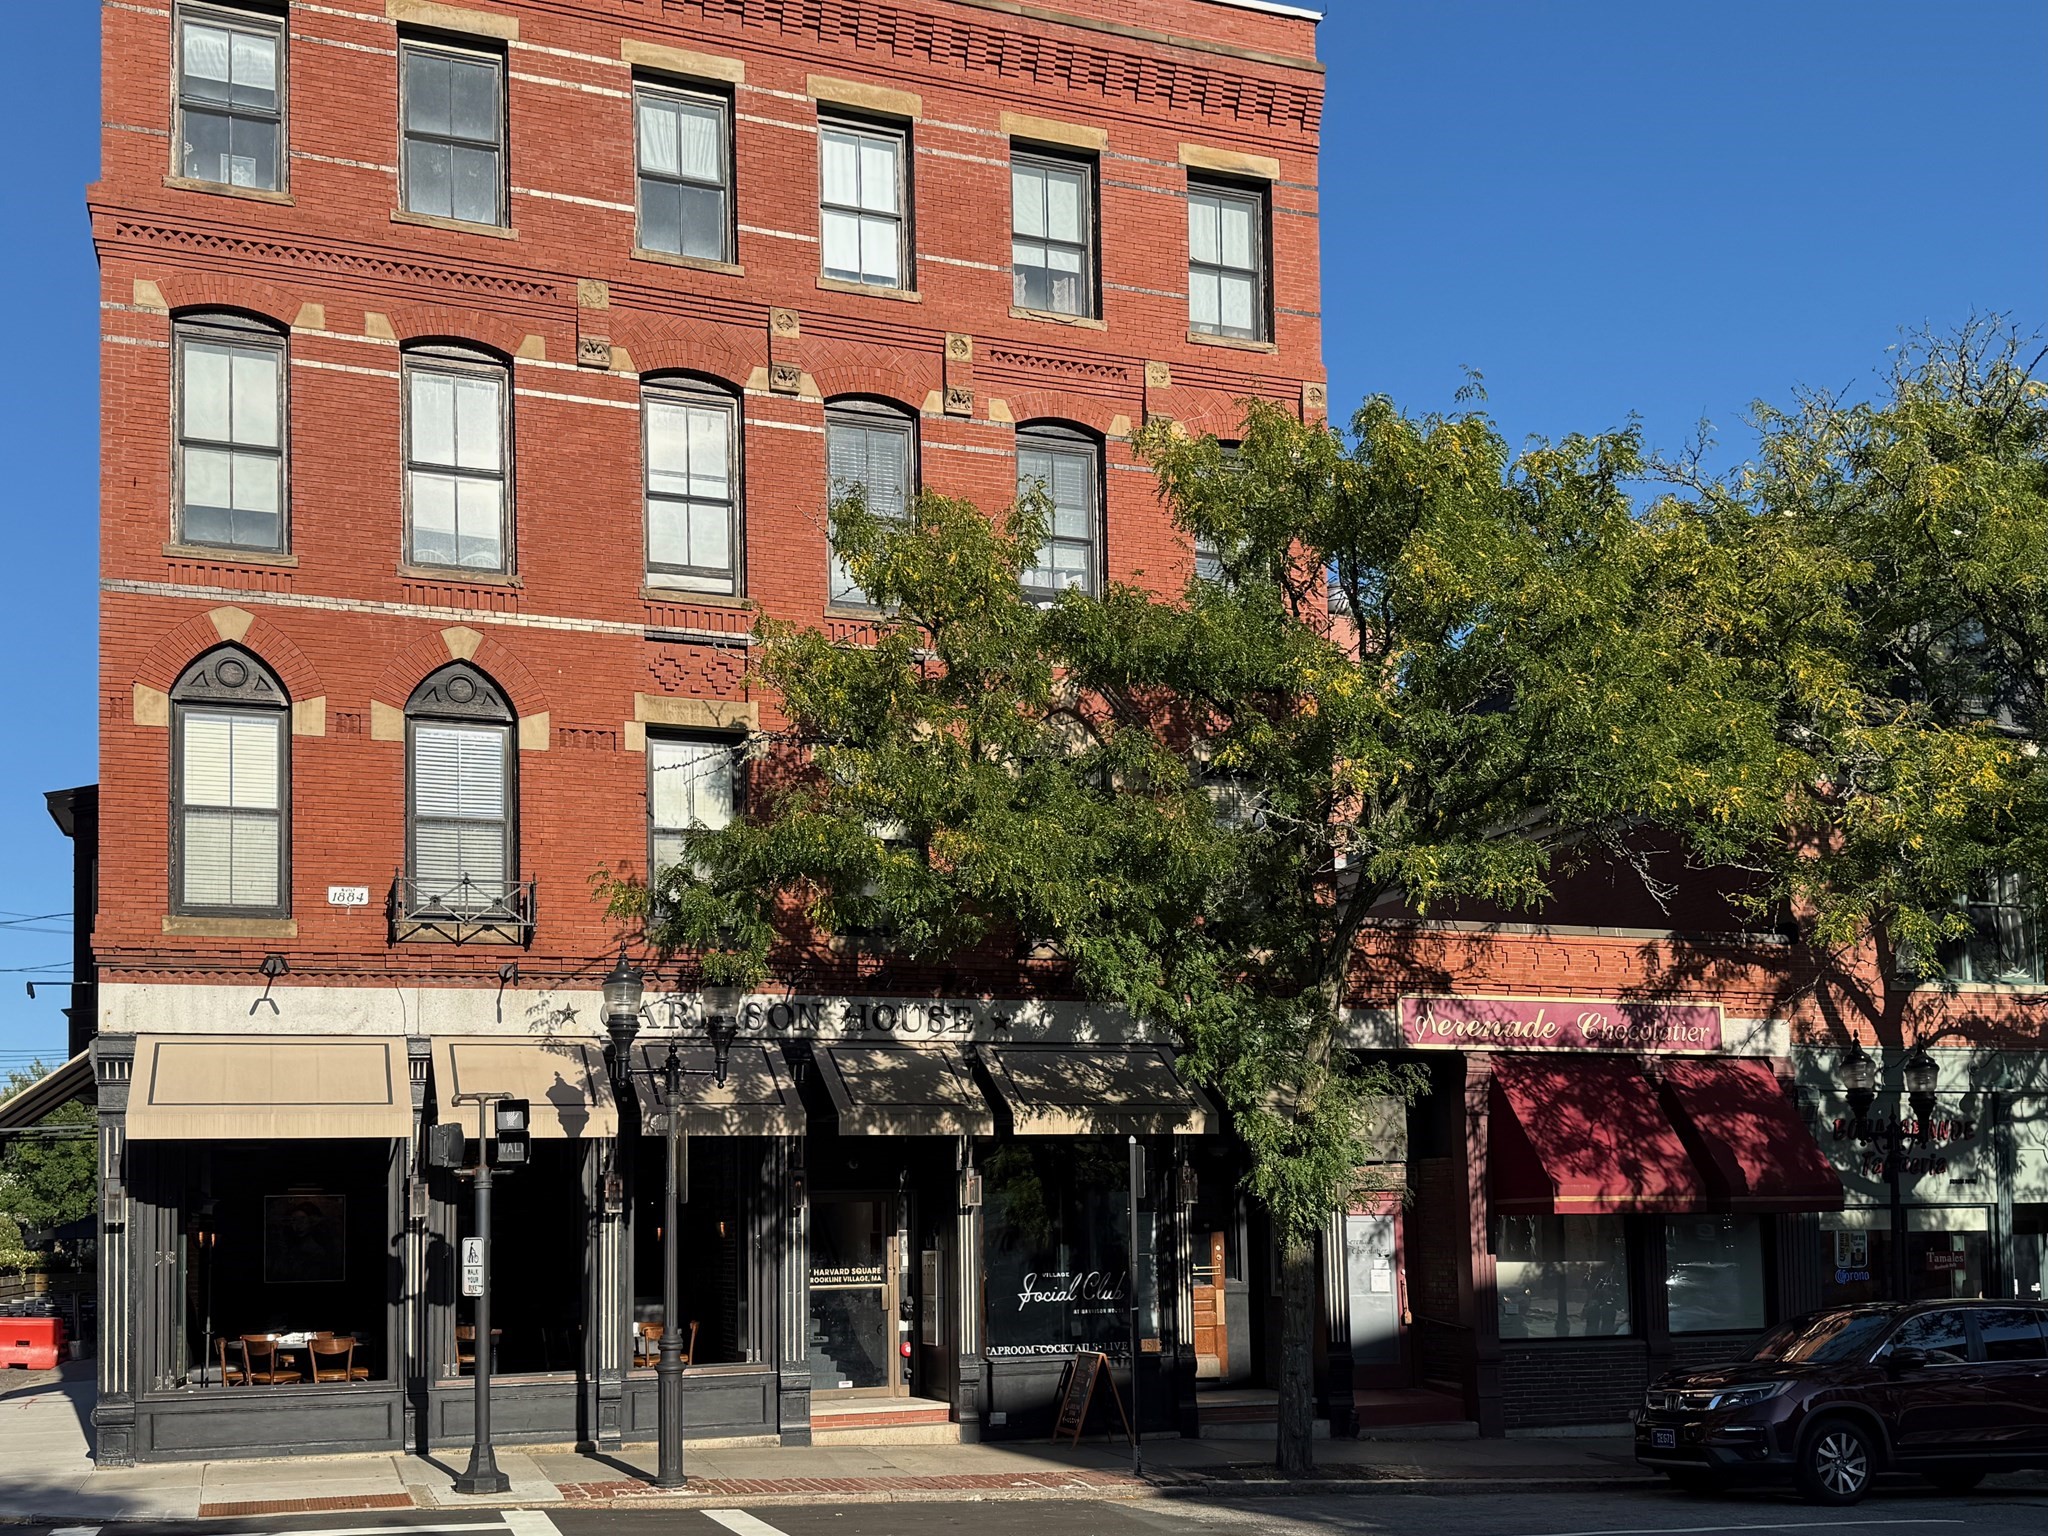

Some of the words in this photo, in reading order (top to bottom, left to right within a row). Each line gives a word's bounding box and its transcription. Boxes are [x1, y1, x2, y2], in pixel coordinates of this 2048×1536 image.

[332, 892, 364, 903] 1884
[599, 1000, 824, 1031] ARSON
[840, 1003, 974, 1034] HOUSE
[1415, 1000, 1561, 1042] Serenade
[1576, 1012, 1711, 1042] Chocolatier
[1861, 1150, 1947, 1177] Taueria
[1926, 1251, 1964, 1263] Tamales
[813, 1268, 850, 1276] HARVARD
[851, 1266, 881, 1275] SQUARE
[810, 1276, 842, 1284] ROOKLINE
[843, 1275, 870, 1283] VILLAGE,
[1017, 1272, 1083, 1311] Social
[1082, 1271, 1126, 1301] Club
[1104, 1343, 1129, 1351] LIVE
